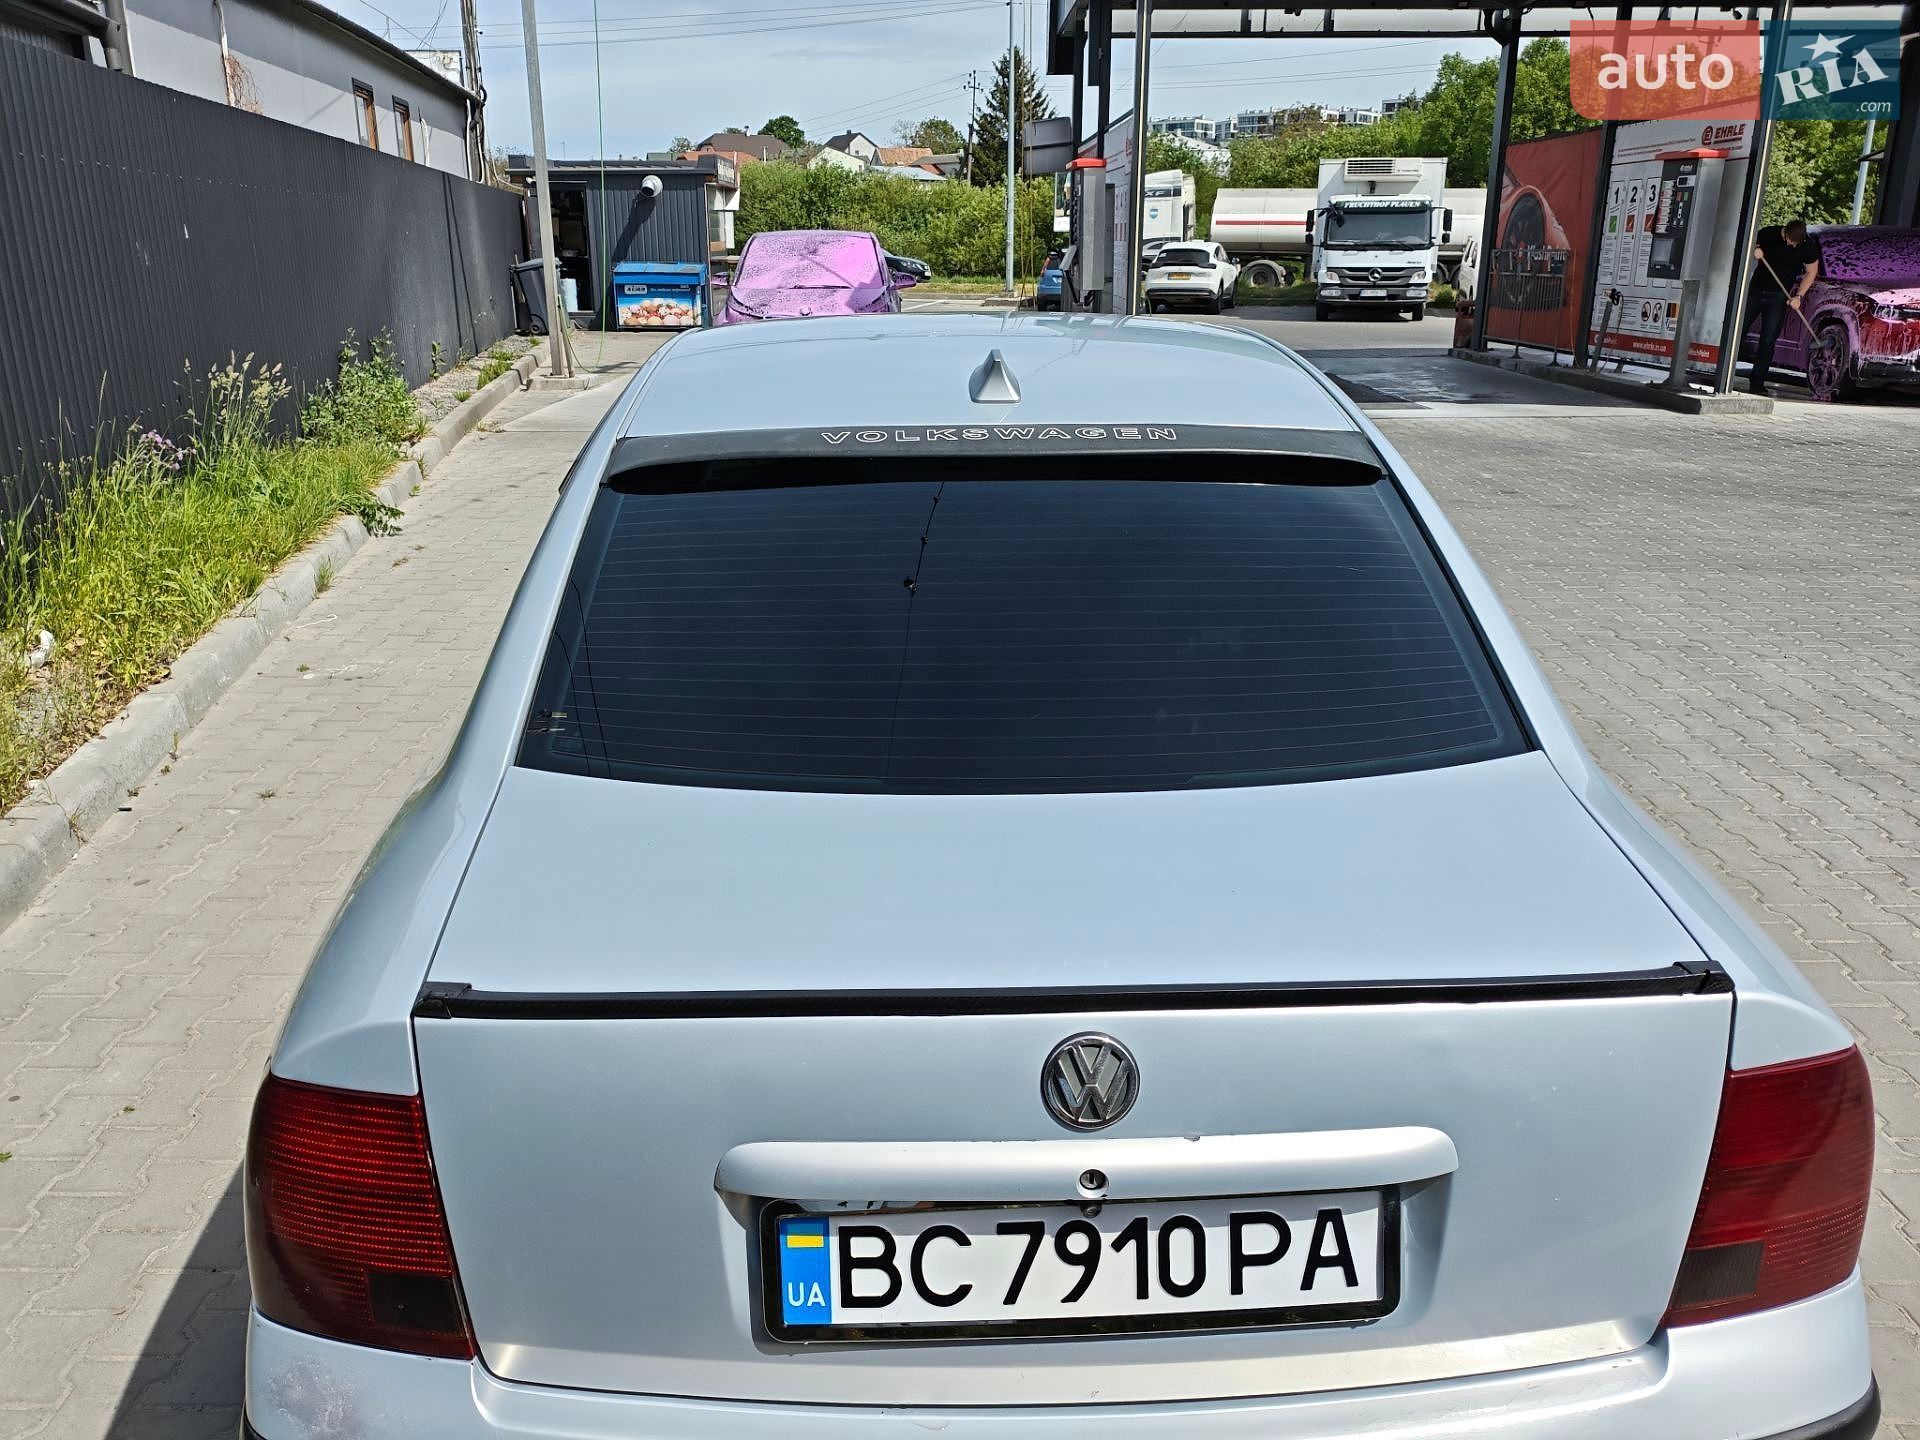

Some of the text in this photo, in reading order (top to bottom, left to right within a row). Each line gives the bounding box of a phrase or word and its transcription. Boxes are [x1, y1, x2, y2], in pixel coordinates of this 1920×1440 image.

[1714, 123, 1746, 139] EHRLE
[1614, 187, 1620, 204] 1
[1630, 186, 1638, 203] 2
[1649, 185, 1656, 202] 3
[820, 427, 1177, 444] VOLKSWAGEN
[838, 1207, 1360, 1309] BC 7910 PA
[786, 1283, 827, 1308] UA
